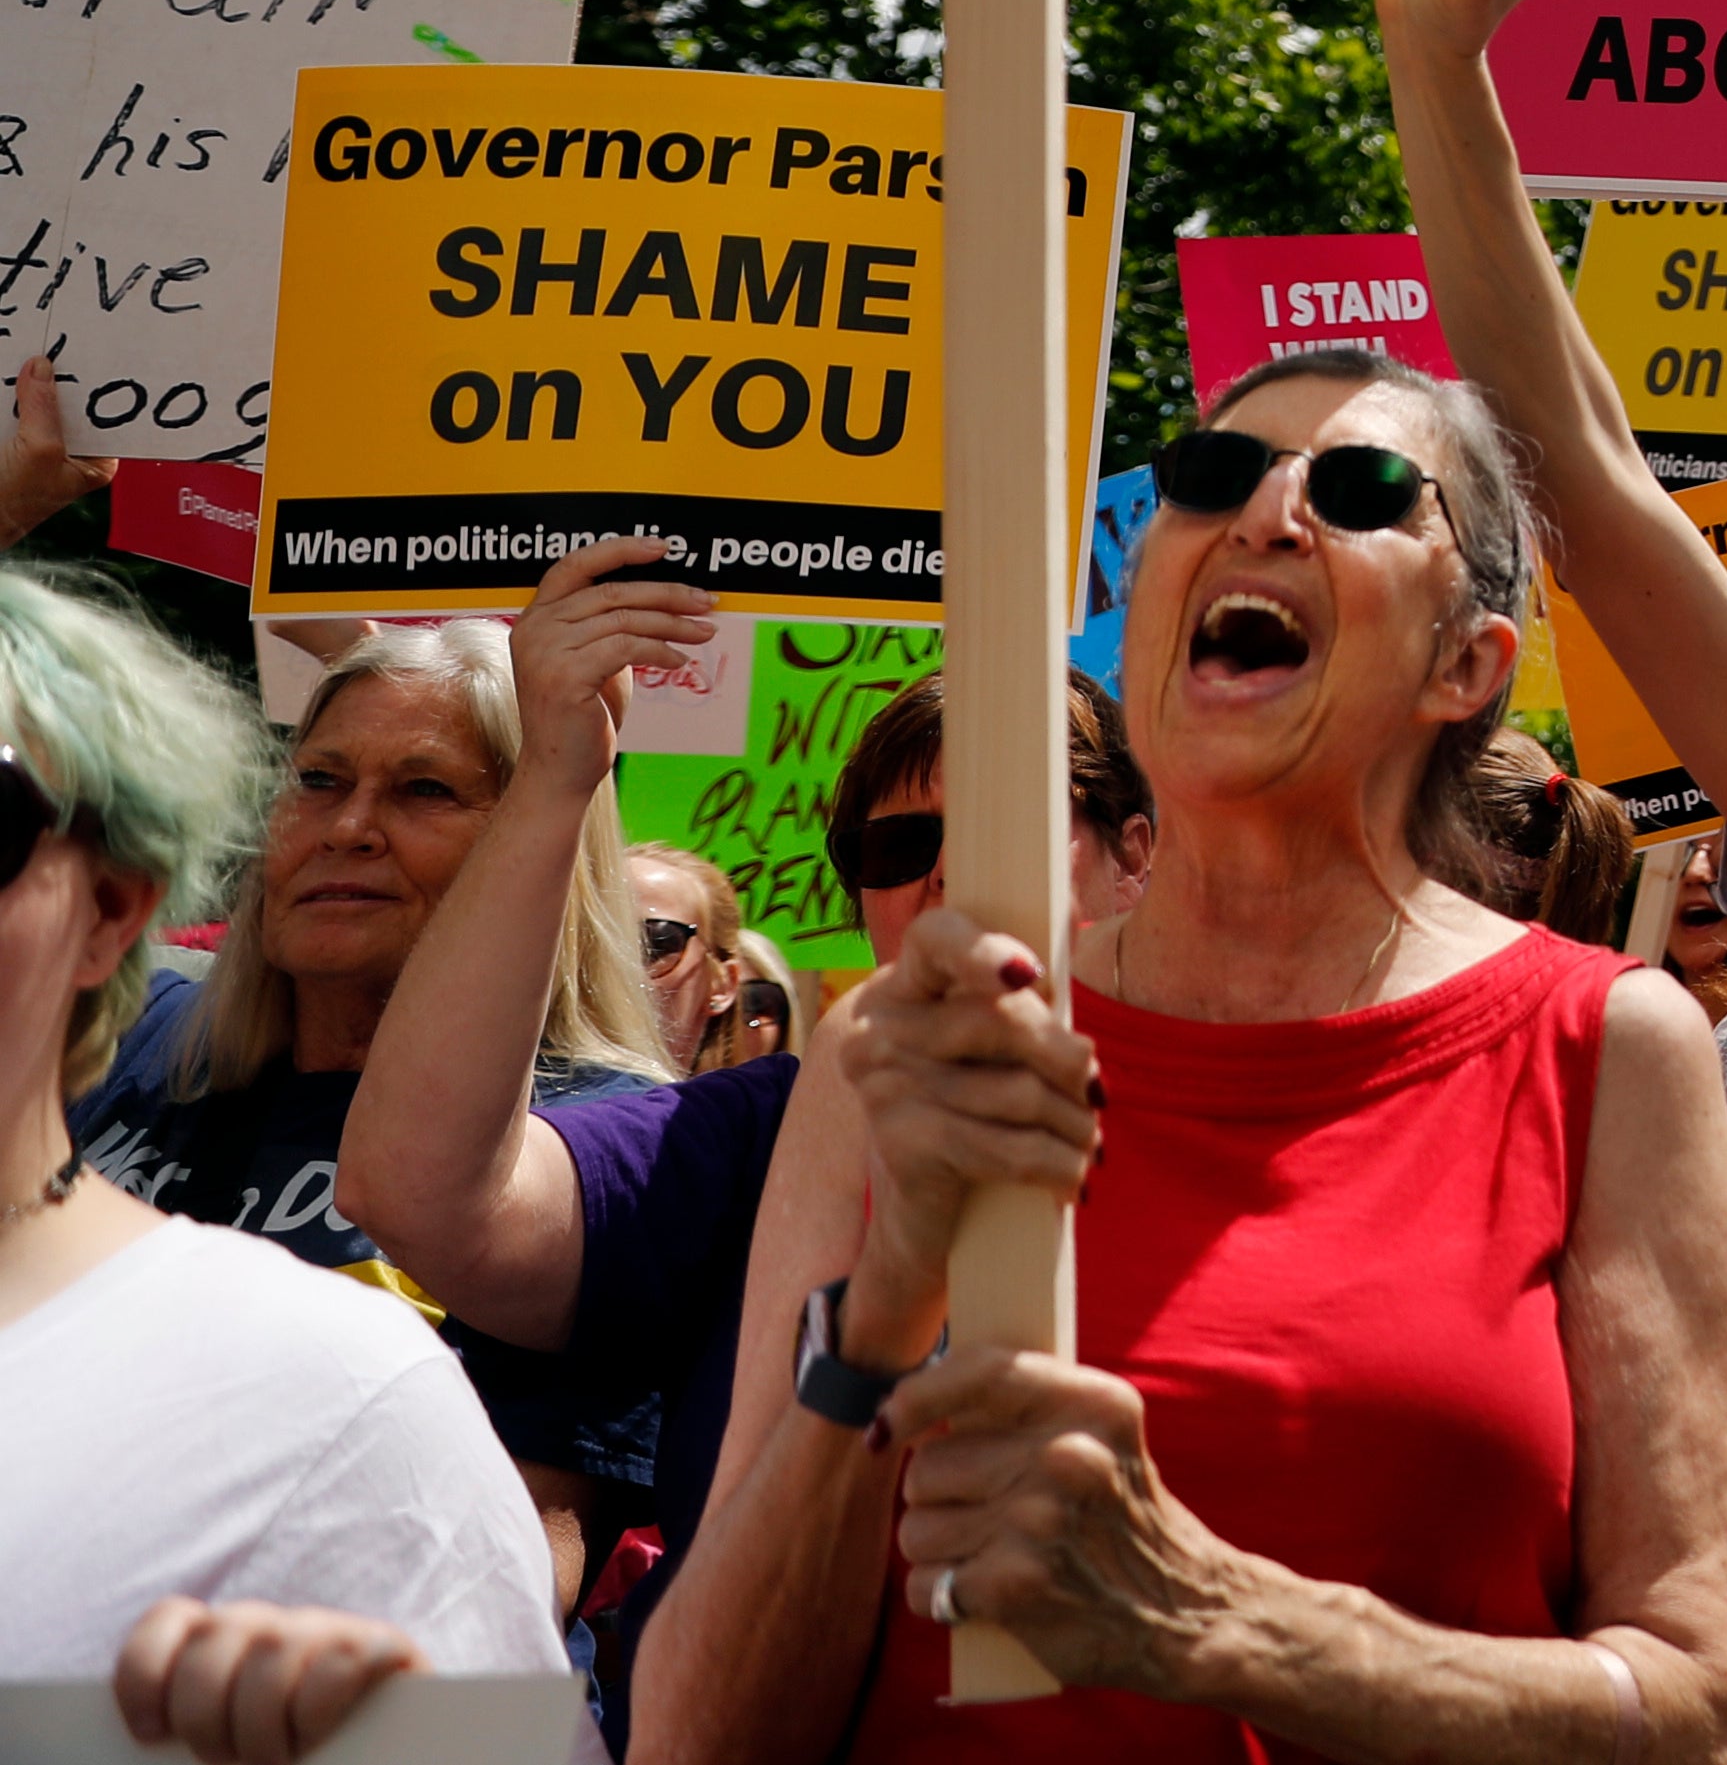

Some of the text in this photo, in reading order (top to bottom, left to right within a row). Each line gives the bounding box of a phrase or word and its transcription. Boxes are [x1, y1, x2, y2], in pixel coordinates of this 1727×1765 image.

[80, 82, 228, 182] his
[312, 114, 751, 187] Governor
[768, 126, 1088, 218] Parn
[428, 226, 920, 337] SHAME
[1260, 279, 1430, 328] I STAND
[428, 351, 913, 459] on YOU
[1644, 345, 1723, 398] on
[285, 529, 398, 568] When
[708, 535, 874, 577] people
[880, 538, 943, 577] die
[1624, 793, 1680, 820] hen
